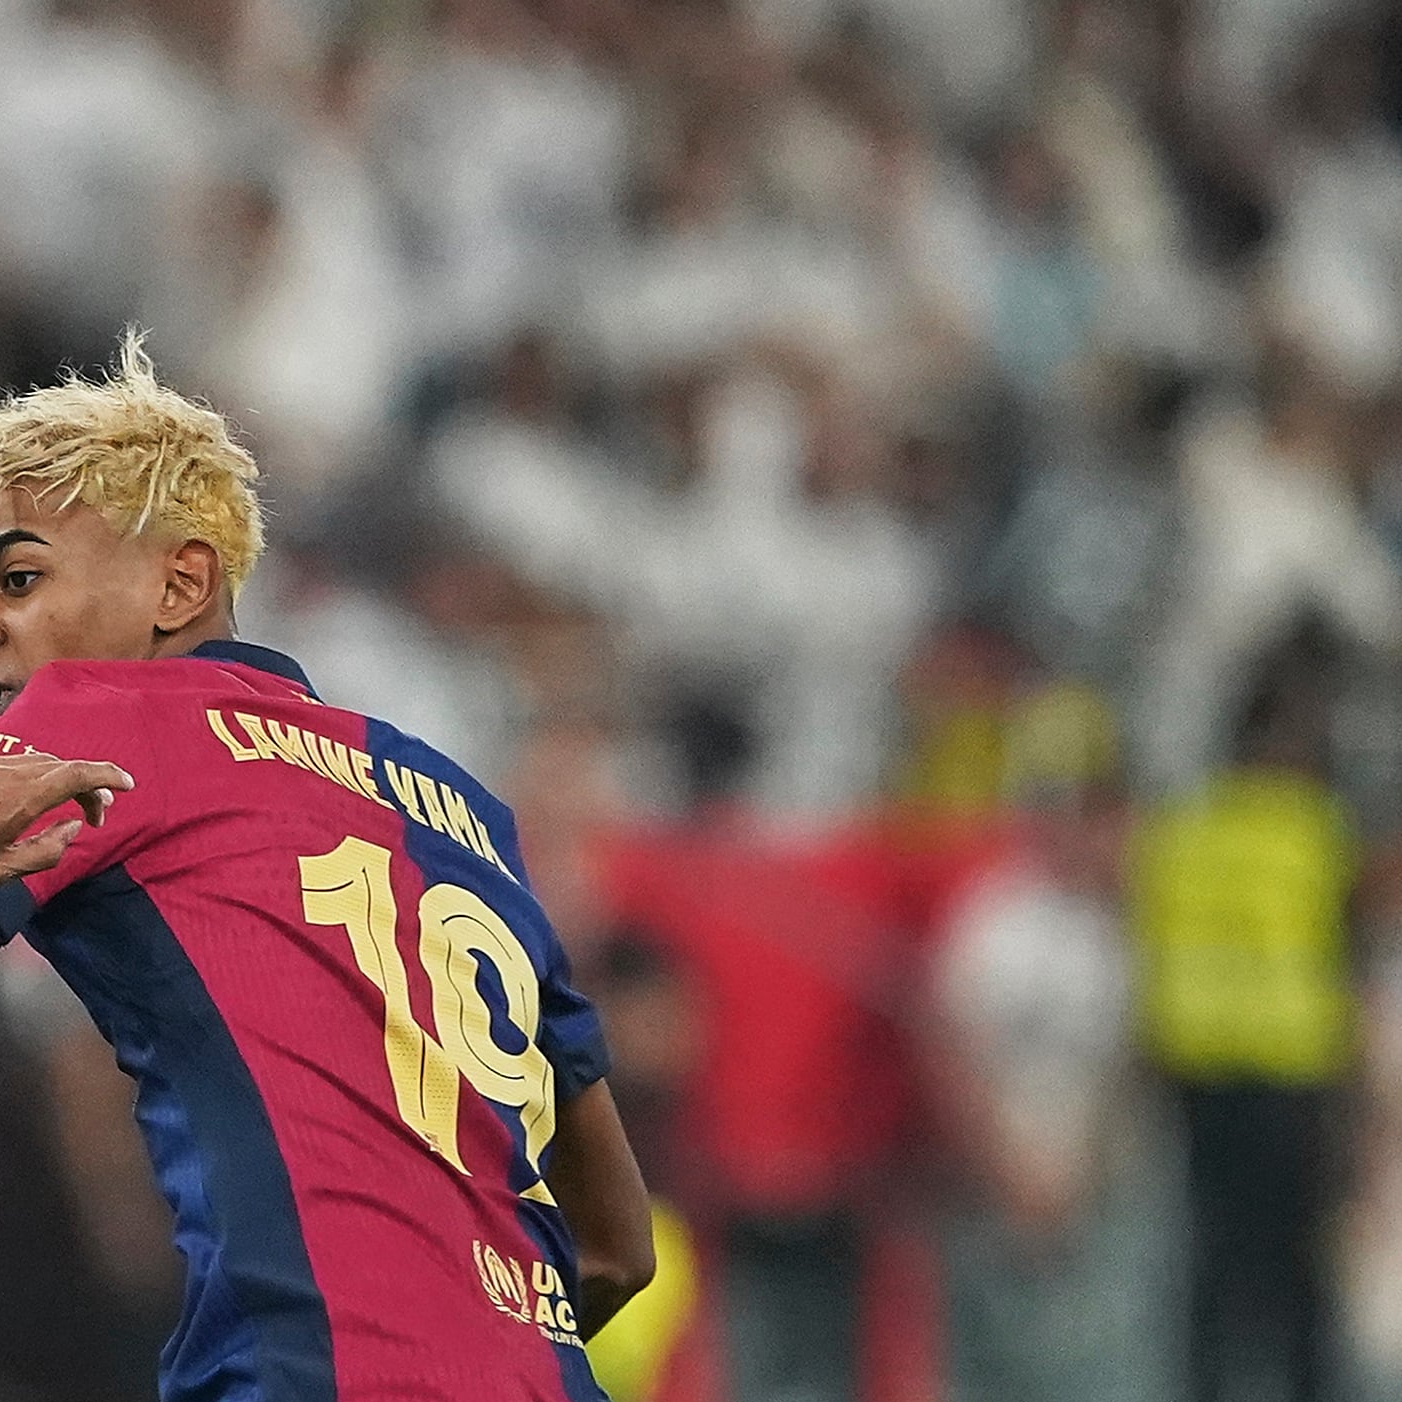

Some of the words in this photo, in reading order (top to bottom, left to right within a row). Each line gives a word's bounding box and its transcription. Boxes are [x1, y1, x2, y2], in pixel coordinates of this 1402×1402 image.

[206, 709, 396, 811] LAMINE
[384, 759, 521, 885] YAMA
[298, 835, 557, 1206] 19
[536, 1296, 577, 1332] AC
